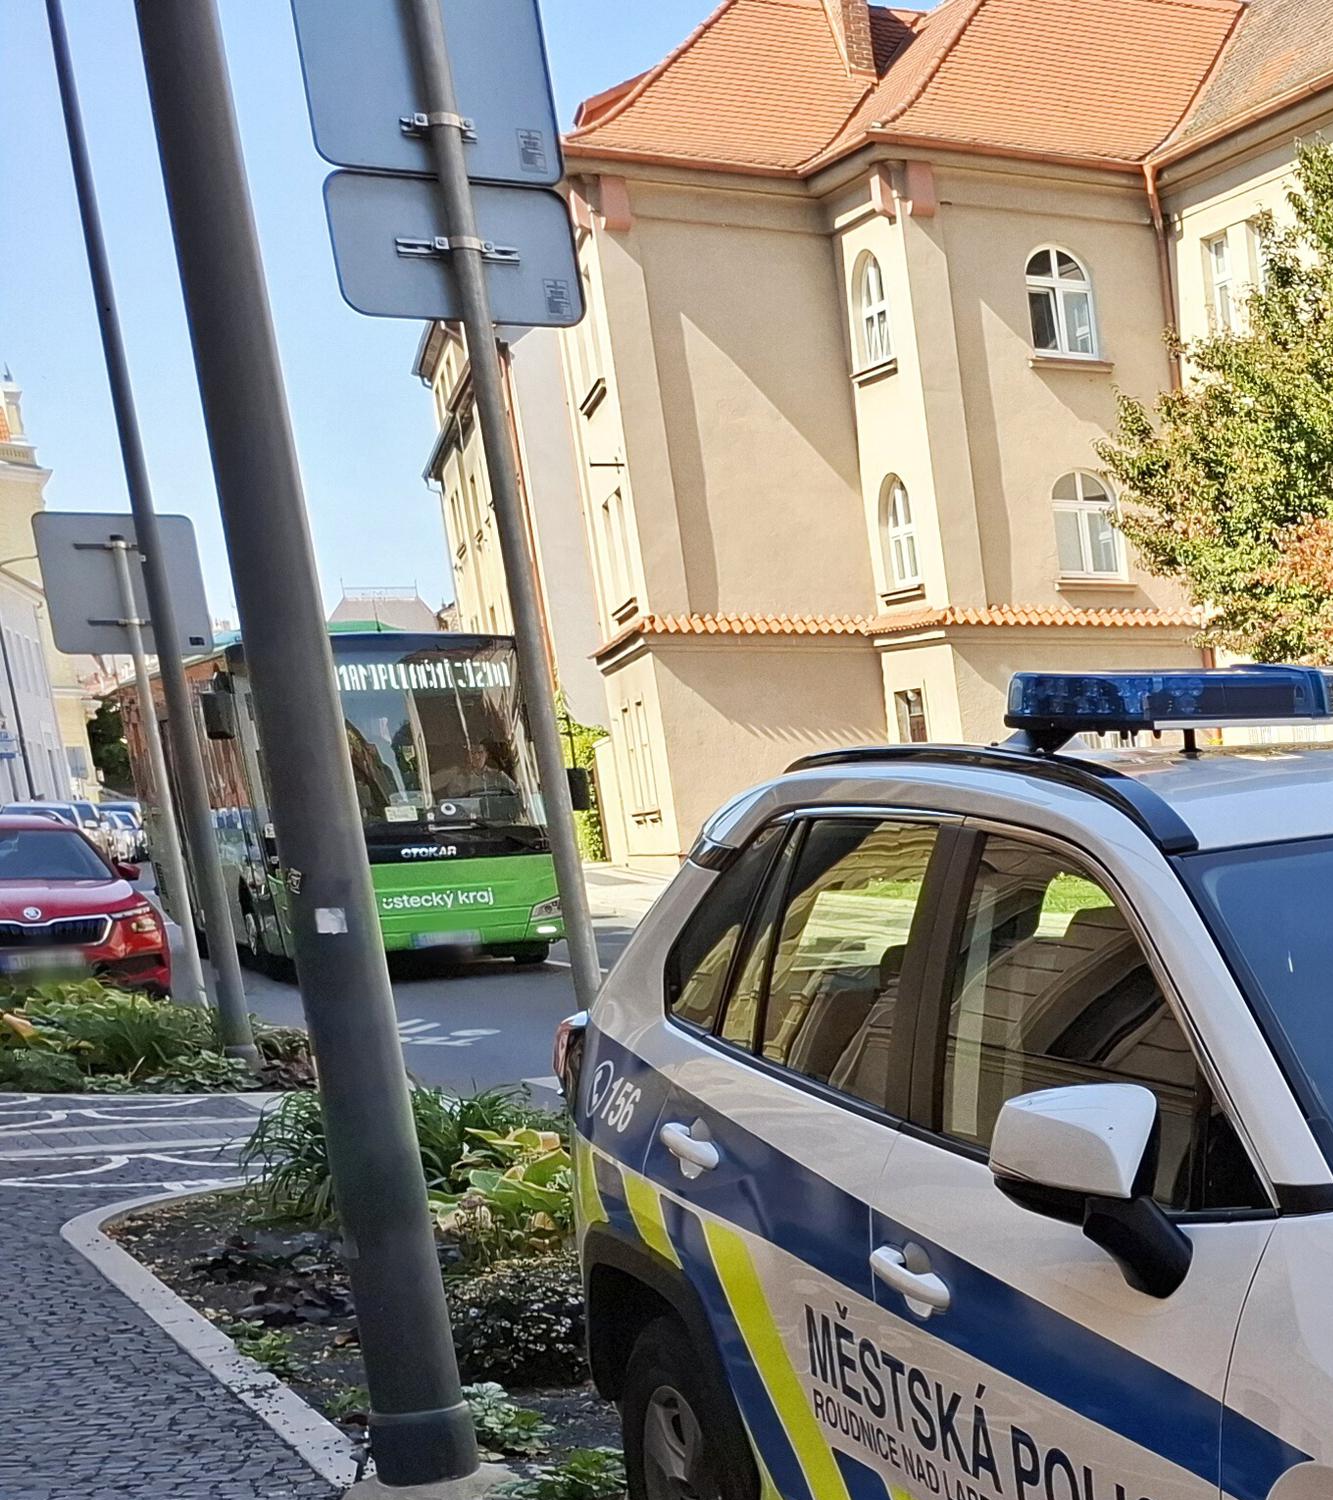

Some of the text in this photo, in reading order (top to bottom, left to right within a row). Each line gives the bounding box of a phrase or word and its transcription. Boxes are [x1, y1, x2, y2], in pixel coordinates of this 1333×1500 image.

[401, 846, 457, 858] OTOKAR
[458, 887, 494, 906] kraj
[600, 1076, 642, 1134] 156
[804, 1301, 1003, 1495] MĚSTSKÁ
[812, 1388, 902, 1470] ROUDNICE
[901, 1444, 941, 1495] NAD
